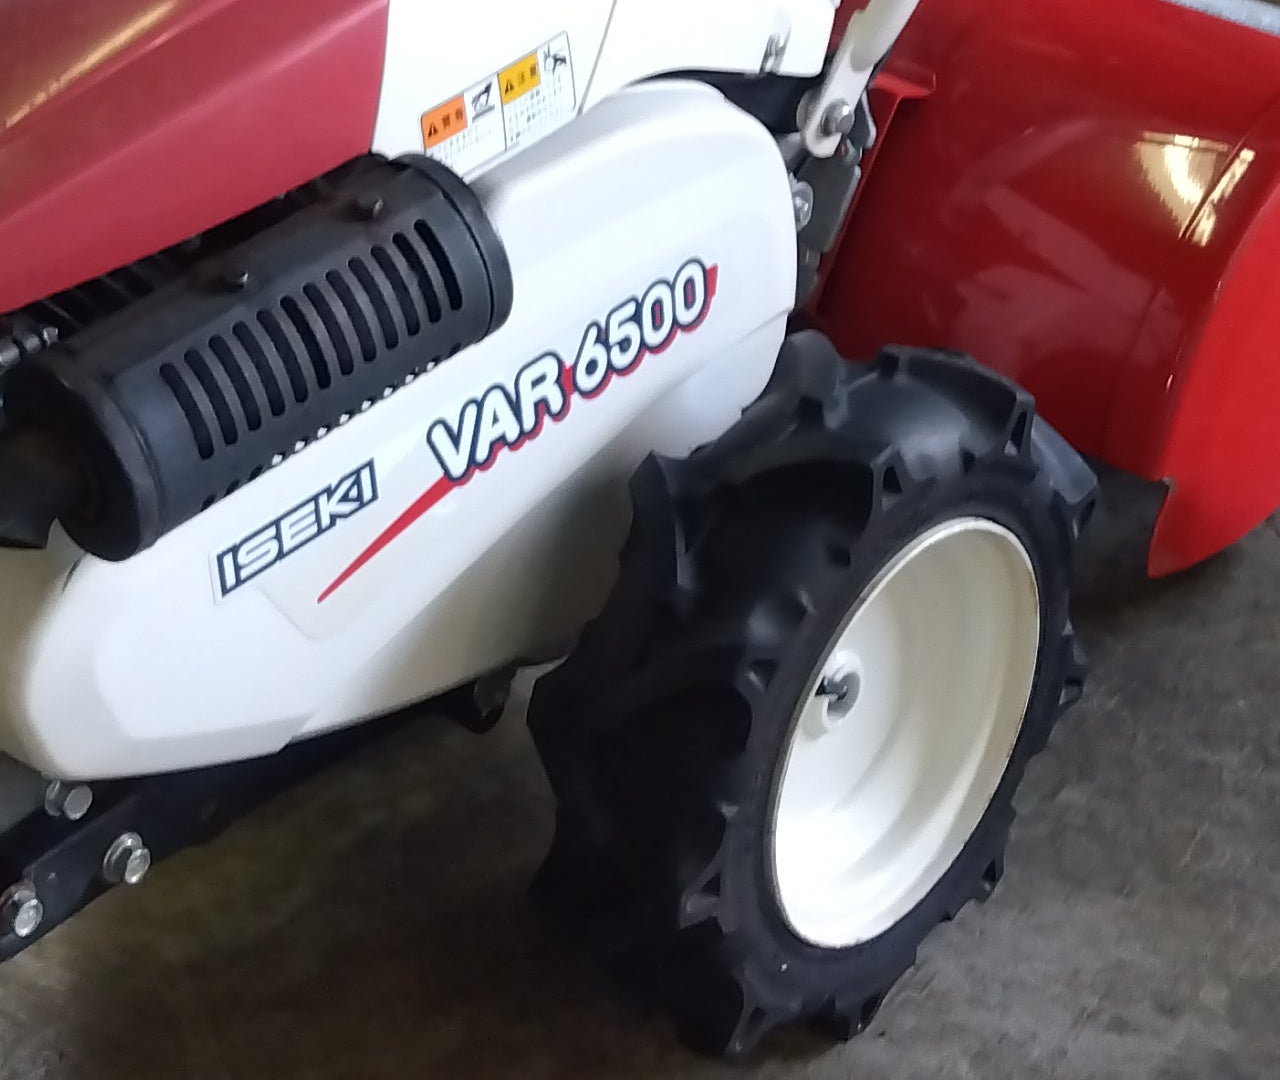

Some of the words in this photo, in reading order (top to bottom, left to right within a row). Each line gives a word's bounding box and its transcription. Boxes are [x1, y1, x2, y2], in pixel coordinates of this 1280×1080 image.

[217, 457, 379, 598] ISEKI
[426, 350, 567, 484] VAR
[573, 255, 710, 397] 6500
